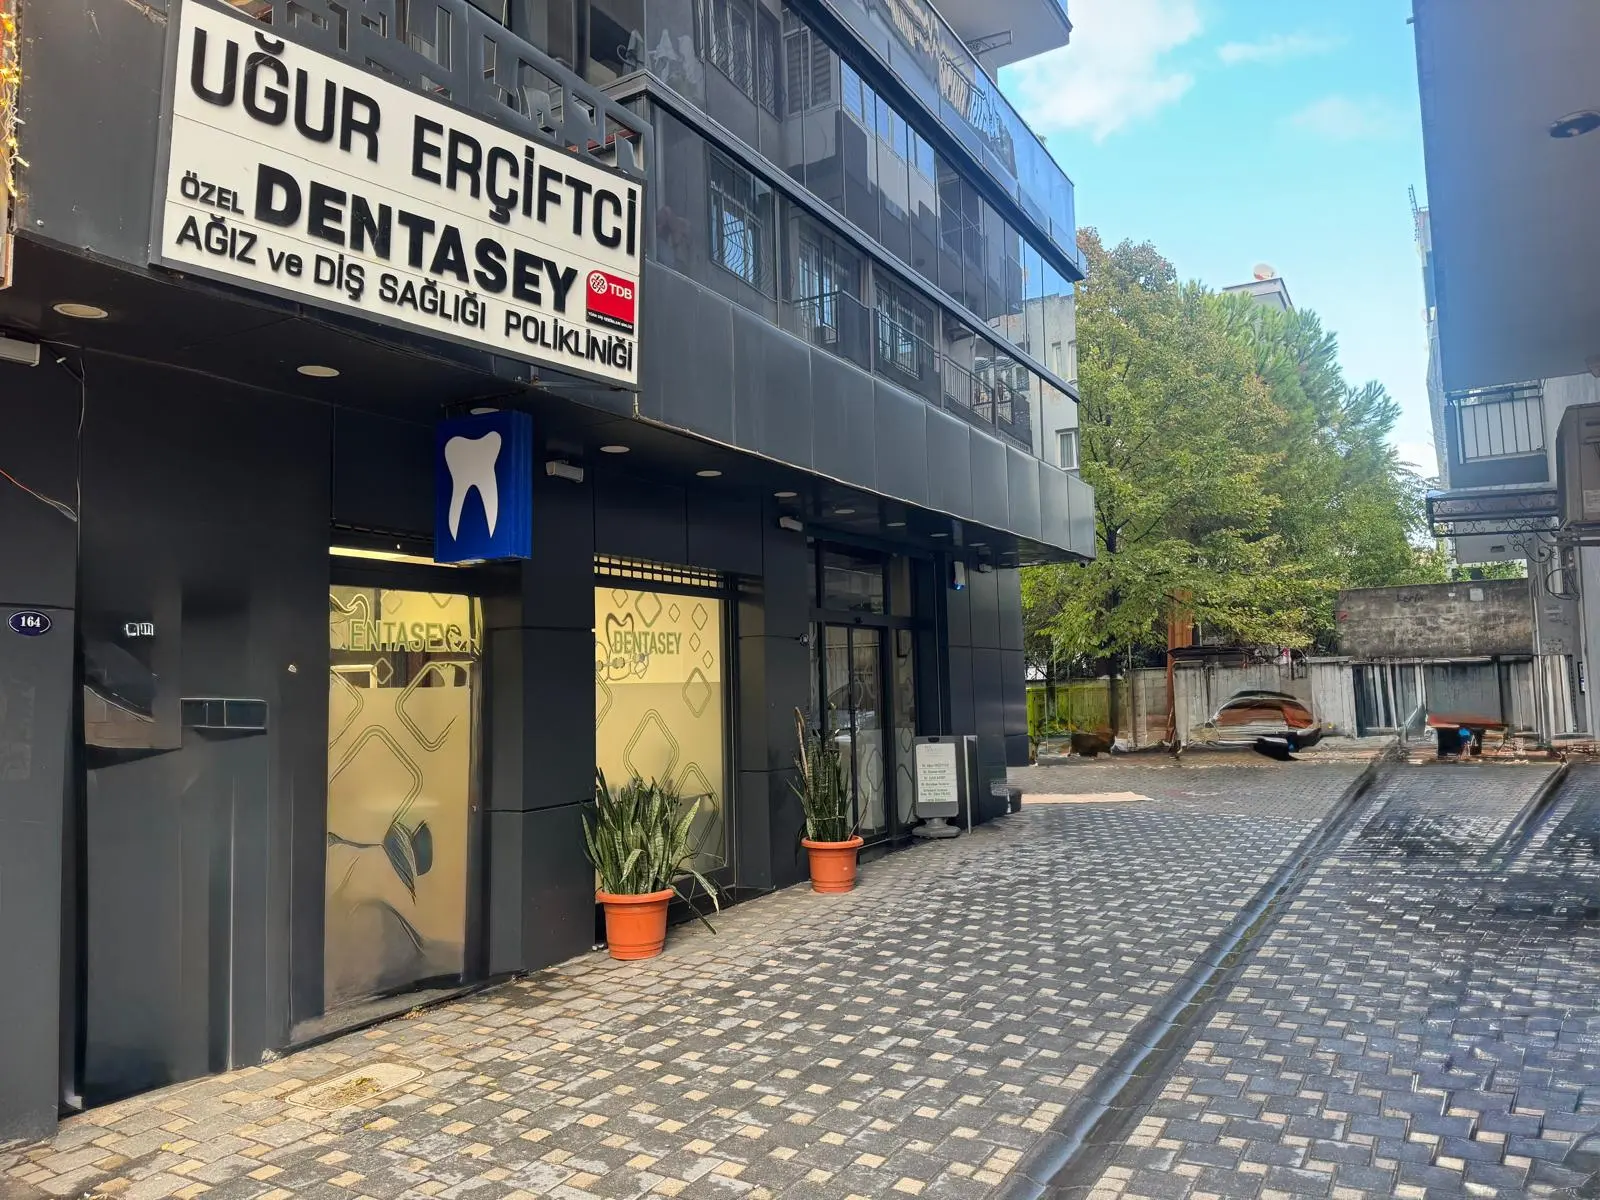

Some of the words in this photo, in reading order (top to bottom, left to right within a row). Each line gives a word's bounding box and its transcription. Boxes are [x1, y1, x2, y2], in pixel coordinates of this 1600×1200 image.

[191, 27, 380, 162] UĞUR
[412, 115, 638, 257] ERÇİFTCİ
[180, 170, 244, 215] ÖZEL
[255, 164, 578, 313] DENTASEY
[175, 213, 258, 265] AĞIZ
[268, 247, 303, 277] ve
[314, 253, 365, 301] DİŞ
[379, 274, 487, 331] SAĞLIĞI
[504, 309, 633, 372] POLİKLİNİĞİ
[609, 282, 633, 300] TDB
[20, 616, 41, 628] 164
[613, 630, 682, 655] DENTASEY
